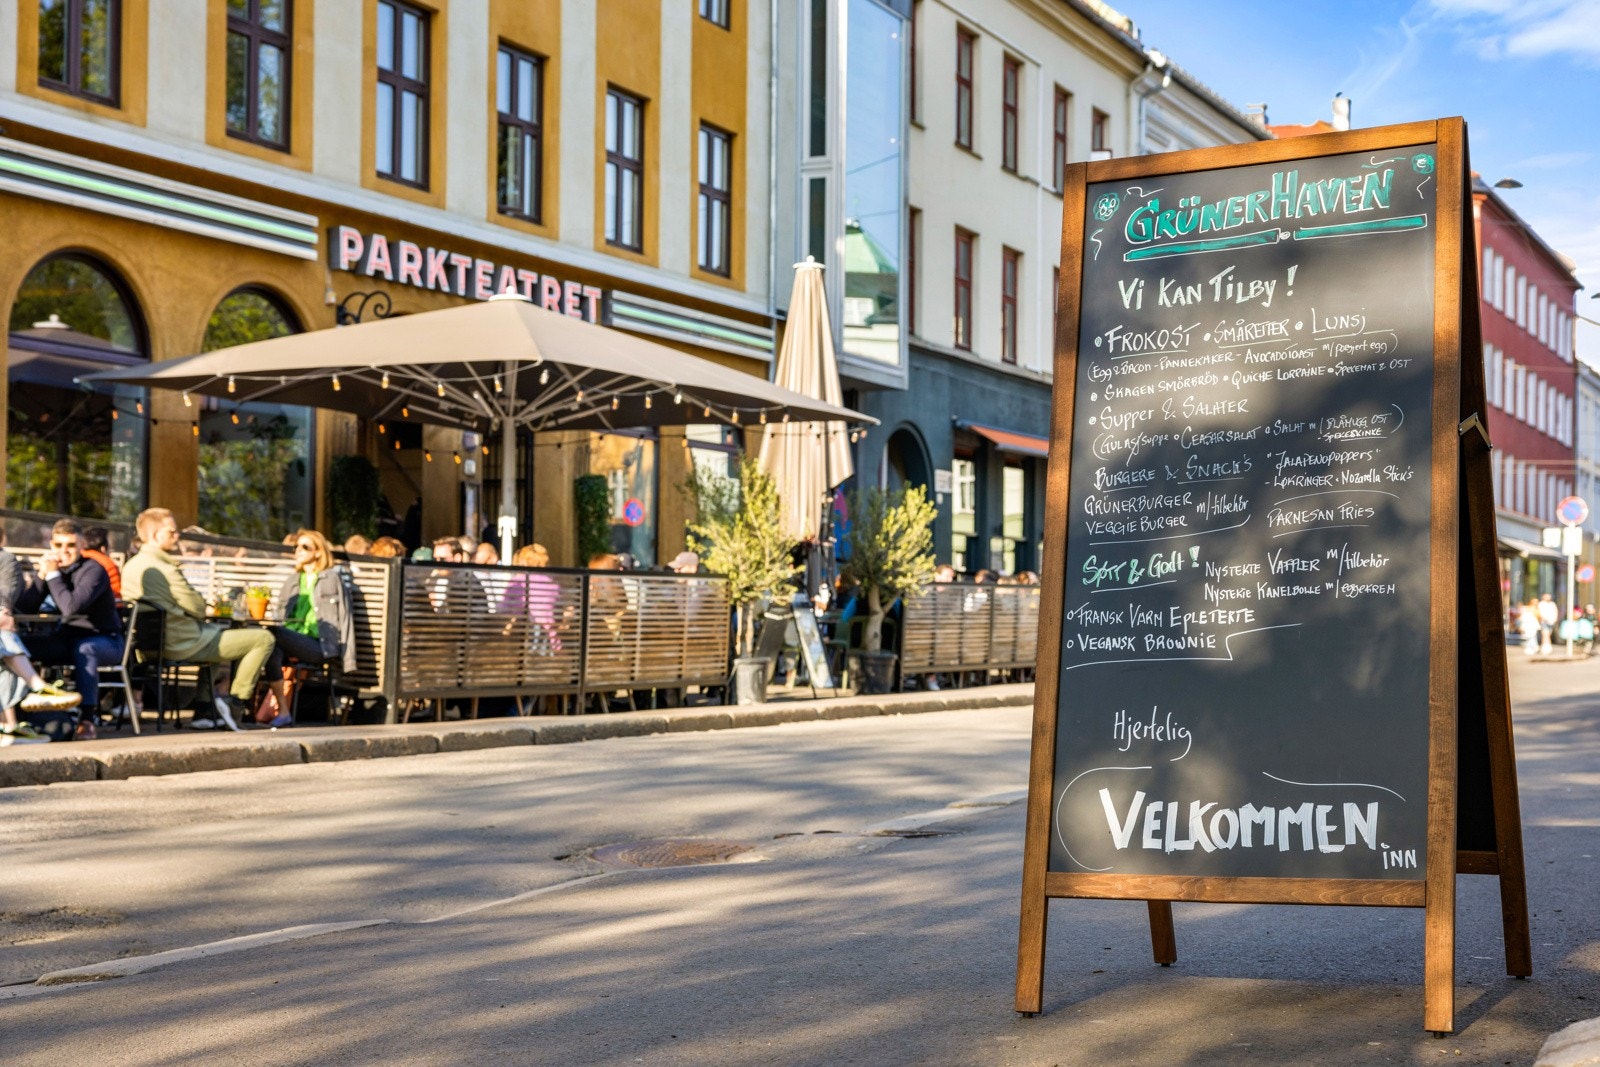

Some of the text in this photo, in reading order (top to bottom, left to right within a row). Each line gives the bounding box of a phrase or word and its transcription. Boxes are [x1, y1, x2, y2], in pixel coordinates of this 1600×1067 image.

[339, 225, 602, 324] PARKTEATRET
[1158, 277, 1202, 308] KAN
[1104, 323, 1201, 353] FROKOST
[1104, 384, 1155, 401] SKAGEN
[1158, 371, 1219, 392] SMÖRBRÖD
[1390, 358, 1412, 370] OST
[1161, 397, 1176, 420] &
[1183, 395, 1249, 419] SALATER
[1274, 418, 1305, 436] SALAT
[1094, 467, 1156, 490] BURGERE
[1165, 465, 1179, 481] &
[1268, 548, 1320, 575] VAFFLER
[1074, 602, 1124, 627] FRANSK
[1077, 634, 1136, 651] VEGANSK
[1113, 705, 1192, 761] Hjertelig
[1099, 788, 1379, 854] VELKOMMEN
